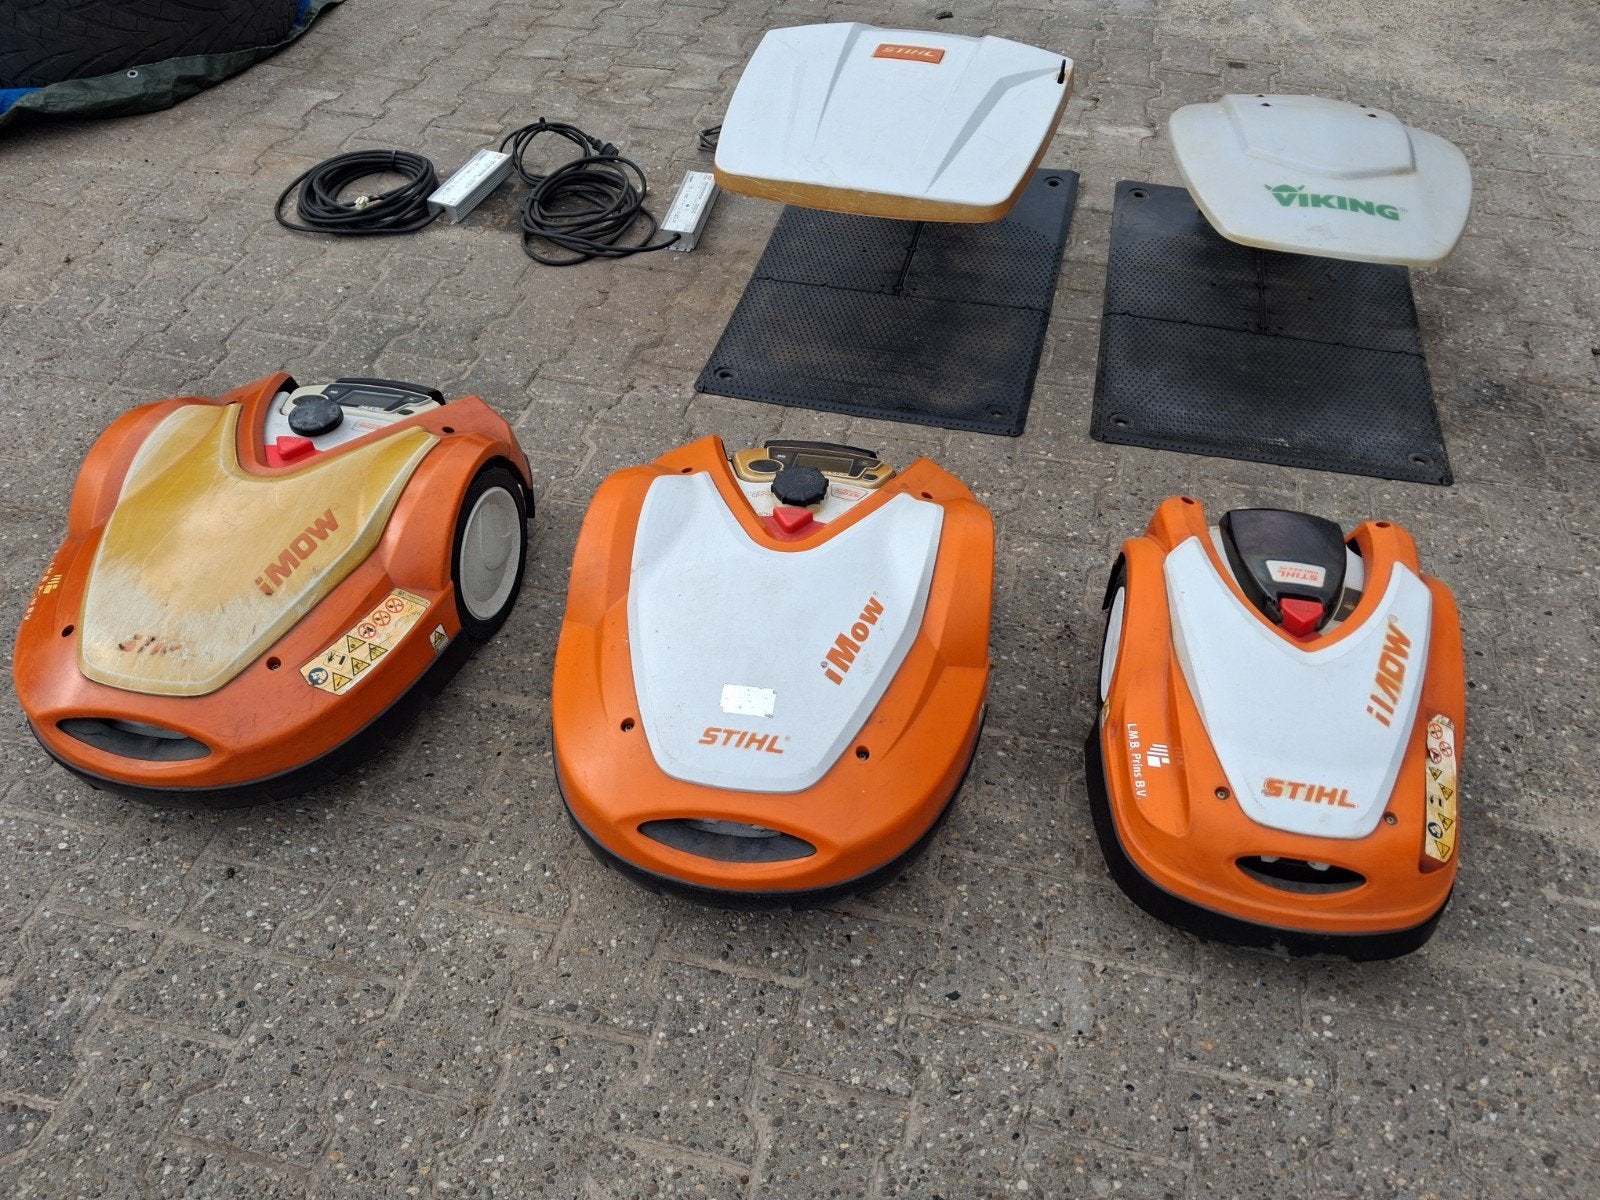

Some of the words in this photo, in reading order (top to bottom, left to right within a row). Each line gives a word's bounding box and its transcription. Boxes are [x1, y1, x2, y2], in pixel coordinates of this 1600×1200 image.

[881, 46, 937, 57] STIHL
[1271, 191, 1400, 221] VIKING
[254, 507, 340, 596] iMOW
[1276, 568, 1319, 582] STIHL
[698, 726, 784, 754] STIHL
[1131, 752, 1144, 778] Prins
[1260, 777, 1359, 809] STIHL
